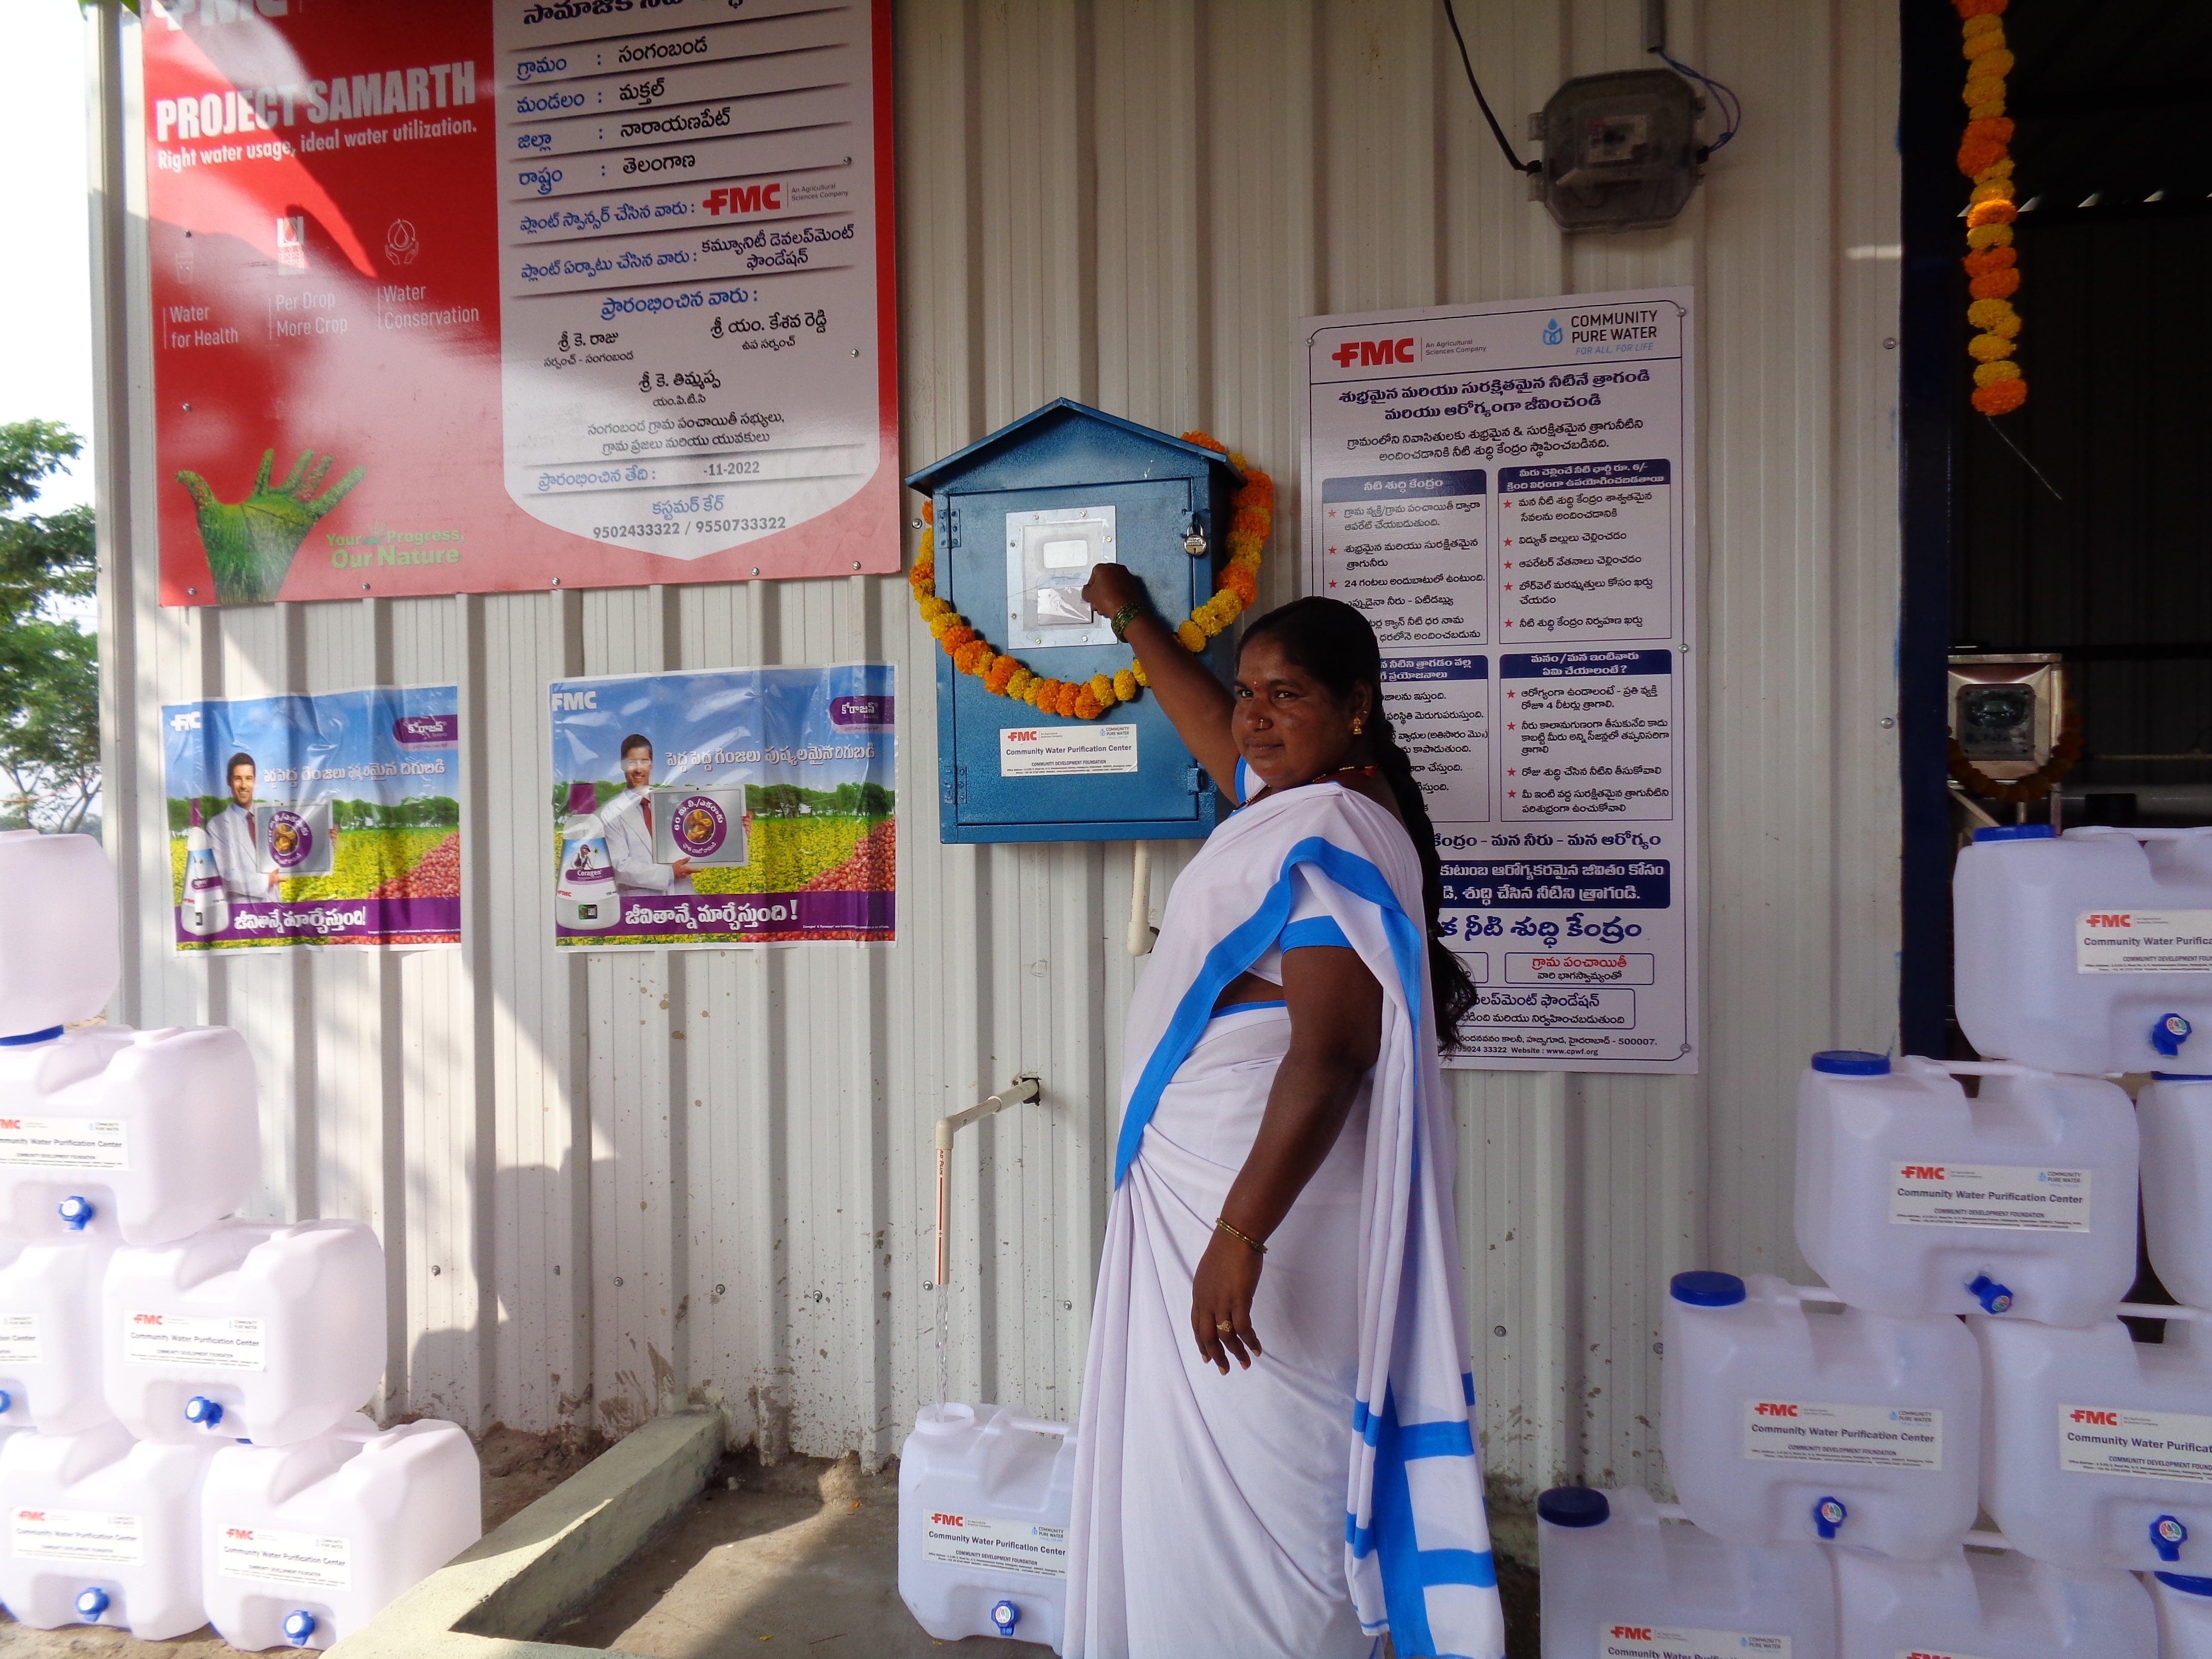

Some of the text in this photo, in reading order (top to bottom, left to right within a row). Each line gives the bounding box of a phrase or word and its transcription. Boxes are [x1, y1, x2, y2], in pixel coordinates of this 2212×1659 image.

[516, 36, 708, 81] గ్రామం సంగంబండ
[156, 61, 476, 142] PROJECT SAMARTH
[517, 77, 665, 113] మండలం మక్తల్
[517, 107, 731, 152] జిల్లా నారాయణపేట్
[158, 118, 477, 173] Right water usage, ideal water utilization.
[519, 153, 696, 195] రాష్ట్రం తెలంగాణ
[792, 189, 848, 202] Sciences Company
[801, 182, 836, 193] Agricultural
[702, 183, 780, 216] FMC
[520, 201, 687, 234] ప్లాంట్ స్పాన్సర్ చేసిన వారు
[701, 230, 766, 256] కమ్యూనిటీ
[747, 248, 808, 271] ఫౌండేషన్
[276, 292, 336, 311] Per Drop
[384, 285, 426, 303] Water
[170, 305, 210, 322] Water
[601, 289, 748, 322] ప్రారంభించిన వారు
[277, 316, 347, 337] More Crop
[385, 307, 479, 330] Conservation
[710, 310, 828, 339] శ్రీ యం. కేశవ రెడ్డి
[1571, 310, 1658, 328] COMMUNITY
[172, 328, 238, 348] for Health
[557, 330, 619, 352] శ్రీ కె. రాజు
[1437, 339, 1473, 348] Agricultural
[1571, 326, 1657, 343] PURE WATER
[1331, 337, 1414, 368] FMC
[1426, 346, 1486, 357] Sciences Company
[1576, 343, 1653, 355] FOR ALL, FOR LIFE
[638, 370, 721, 392] శ్రీ కె. తిమ్మప్ప
[1339, 370, 1650, 405] శుభ్రమైన మరియు సురక్షితమైన నీటినే త్రాగండి
[1385, 394, 1601, 419] మరియు ఆరోగ్యంగా జీవించండి
[652, 495, 726, 520] కస్టమర్ కేర్
[593, 517, 786, 539] 9502433322 9550733322
[326, 529, 465, 547] Your Progress,
[331, 546, 460, 569] Our Nature
[1359, 579, 1387, 587] గంటలు
[552, 692, 596, 711] FMC
[1008, 731, 1037, 741] FMC
[1491, 830, 1661, 849] మన నీరు మన ఆరోగ్యం
[1465, 912, 1642, 948] నీటి శుద్ధి కేంద్రం
[2086, 915, 2130, 927] FMC
[2084, 937, 2173, 946] Community Water
[1532, 955, 1627, 970] గ్రామ పంచాయితీ
[1901, 1166, 1944, 1180] FMC
[1898, 1188, 2083, 1203] Community Water Purification Center
[133, 1314, 162, 1325] FMC
[131, 1333, 168, 1342] Community
[194, 1336, 234, 1345] Purification
[1755, 1403, 1798, 1417] FMC
[2070, 1410, 2117, 1426] FMC
[1752, 1424, 1934, 1442] Community Water Purification Center
[2068, 1432, 2163, 1449] Community Water
[931, 1513, 963, 1527] FMC
[929, 1531, 969, 1544] Community
[972, 1536, 994, 1546] Water
[996, 1539, 1038, 1552] Purification
[1040, 1547, 1066, 1556] Center
[981, 1553, 1011, 1562] DEVELOPMENT
[1610, 1625, 1652, 1641] FMC
